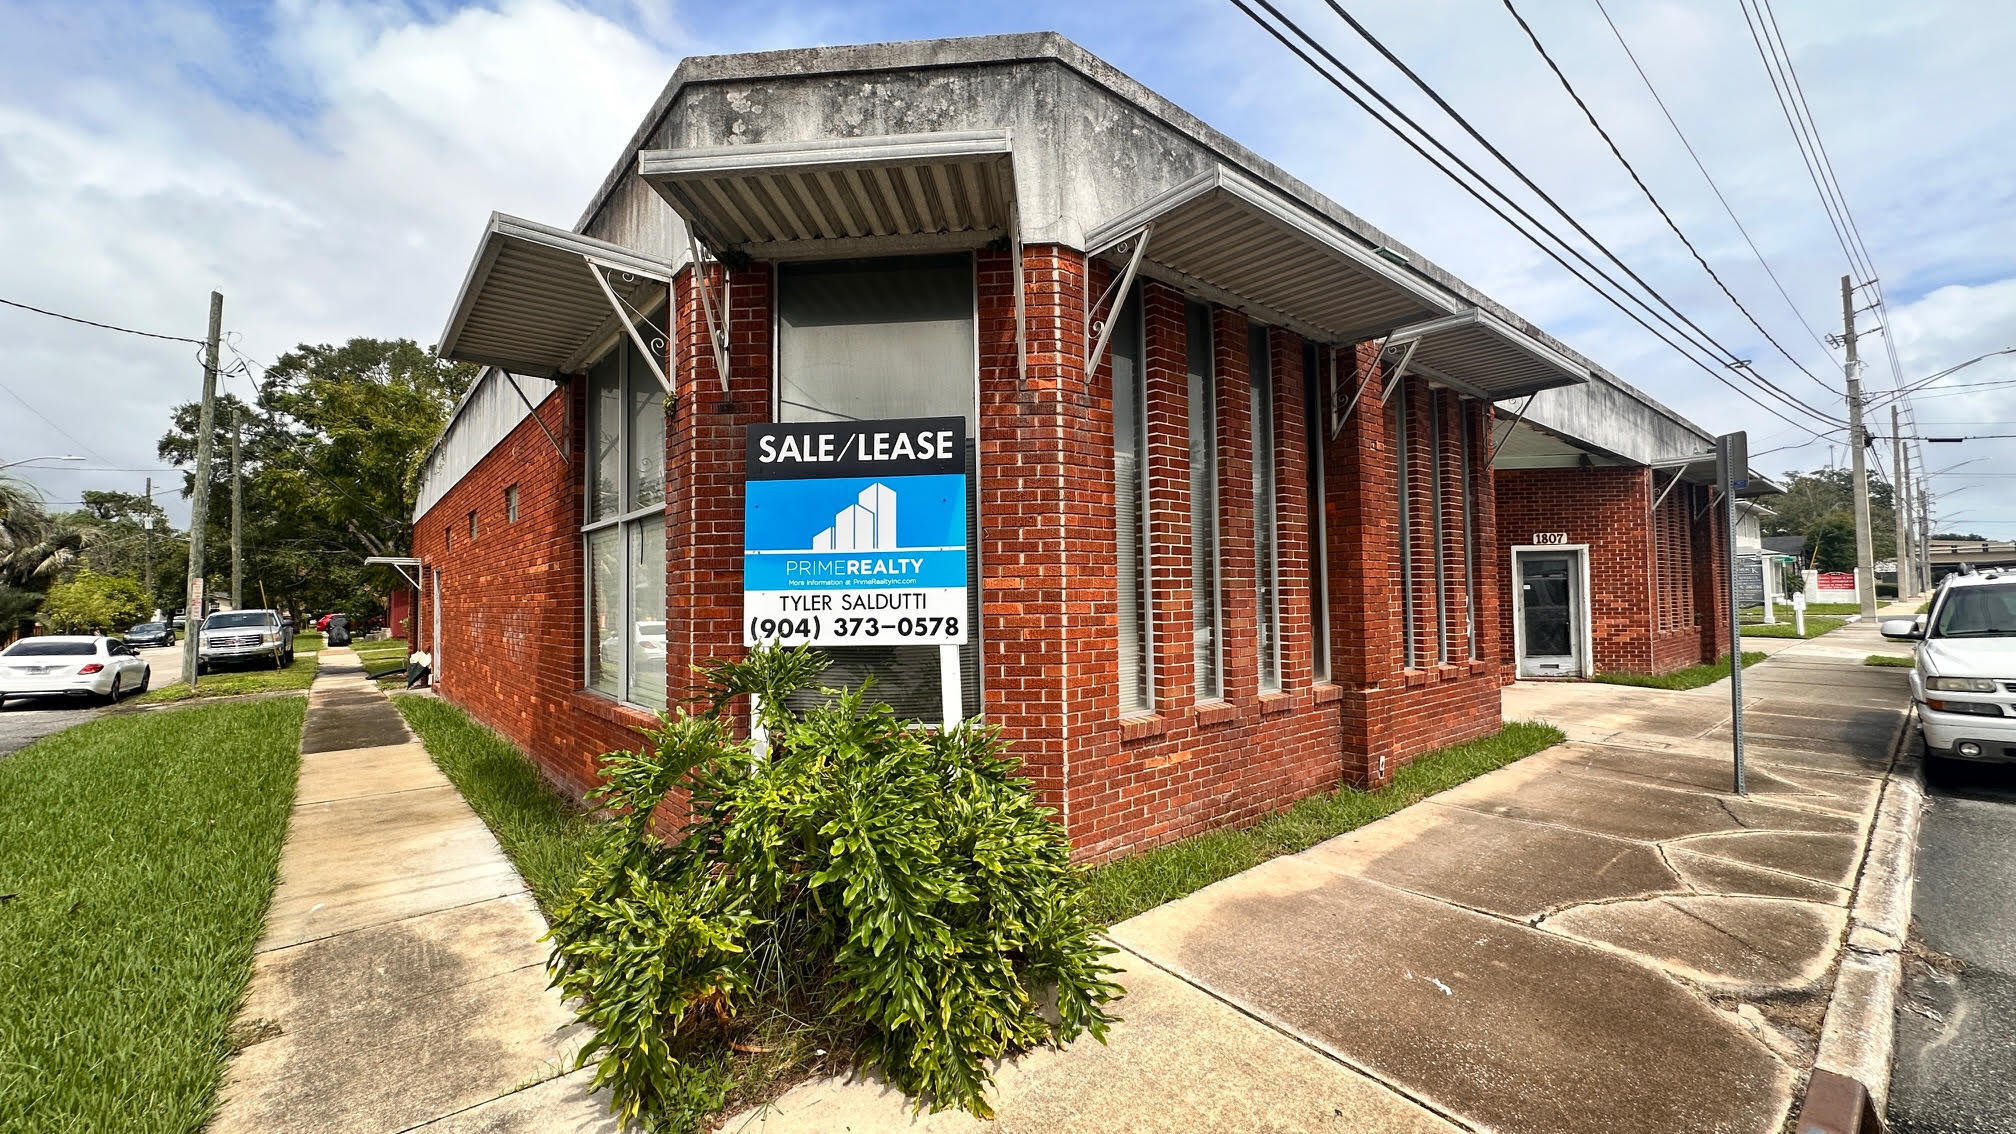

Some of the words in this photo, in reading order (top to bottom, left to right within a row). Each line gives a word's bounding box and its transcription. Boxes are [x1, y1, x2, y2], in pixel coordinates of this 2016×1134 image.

[758, 431, 954, 463] SALE/LEASE
[1535, 533, 1563, 544] 1807
[786, 558, 924, 576] PRIMEREALTY
[780, 595, 832, 611] TYLER
[841, 593, 927, 610] SALDUTTI
[750, 615, 821, 641] (904)
[833, 616, 959, 637] 373-0578
